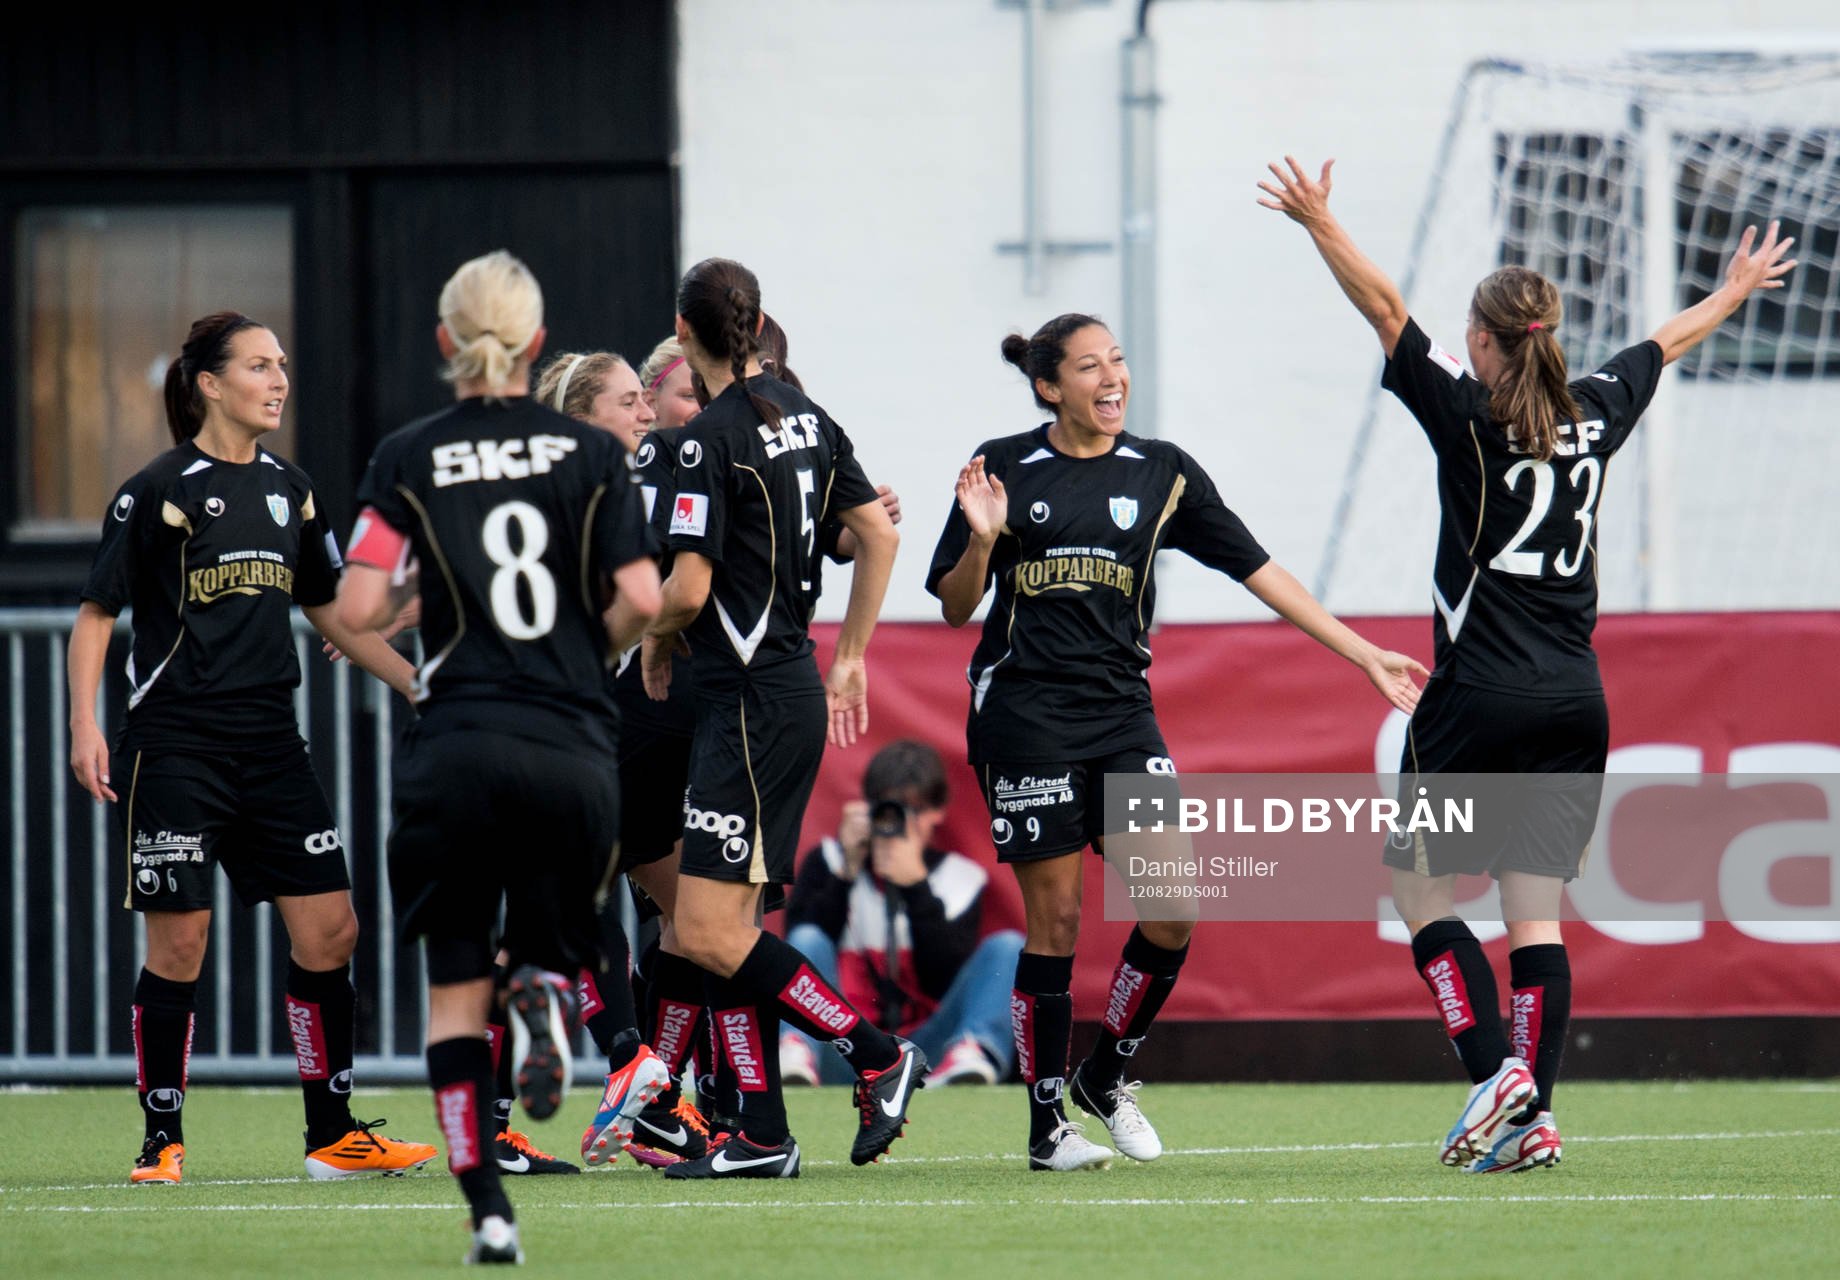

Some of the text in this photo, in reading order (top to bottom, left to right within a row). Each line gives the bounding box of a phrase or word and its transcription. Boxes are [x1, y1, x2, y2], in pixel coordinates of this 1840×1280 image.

[757, 413, 819, 459] SKF
[431, 433, 578, 488] SKF
[796, 469, 815, 591] 5
[1489, 457, 1601, 577] 23
[218, 550, 258, 563] PREMIUM
[482, 501, 557, 640] 8
[1046, 547, 1117, 560] PREMIUM CIDER
[188, 560, 294, 604] KOPPARBER
[1014, 557, 1134, 598] KOPPARBERG
[994, 772, 1071, 794] Åke Ekstrand
[995, 790, 1074, 813] Byggnads AB
[684, 808, 746, 840] oop
[1026, 817, 1041, 842] 9
[132, 848, 205, 867] Byggnads AB
[166, 867, 178, 893] 6
[788, 974, 856, 1032] Stavdal
[1106, 962, 1145, 1031] Stavdal
[1428, 960, 1470, 1029] Stavdal
[287, 1001, 322, 1075] Stavdal
[655, 1004, 691, 1069] Stavda
[722, 1012, 763, 1086] Stavdal
